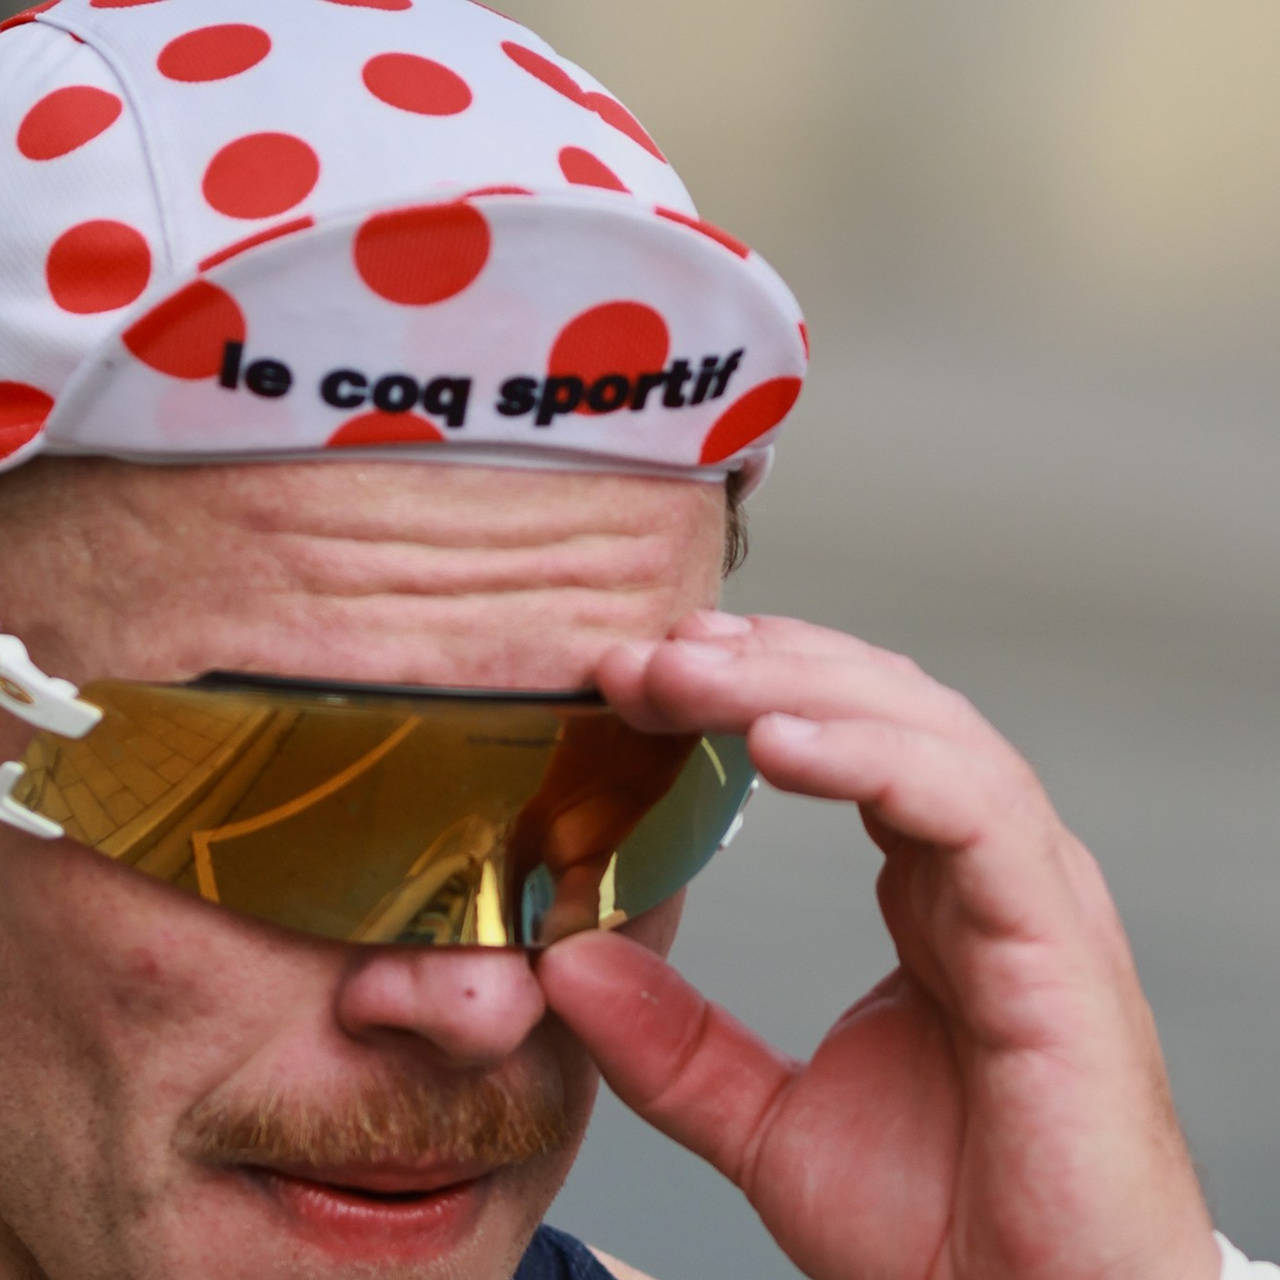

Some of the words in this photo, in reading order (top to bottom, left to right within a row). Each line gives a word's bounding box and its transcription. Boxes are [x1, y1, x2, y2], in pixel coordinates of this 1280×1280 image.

[219, 340, 293, 399] le
[320, 368, 472, 428] coq
[495, 347, 746, 427] sportif
